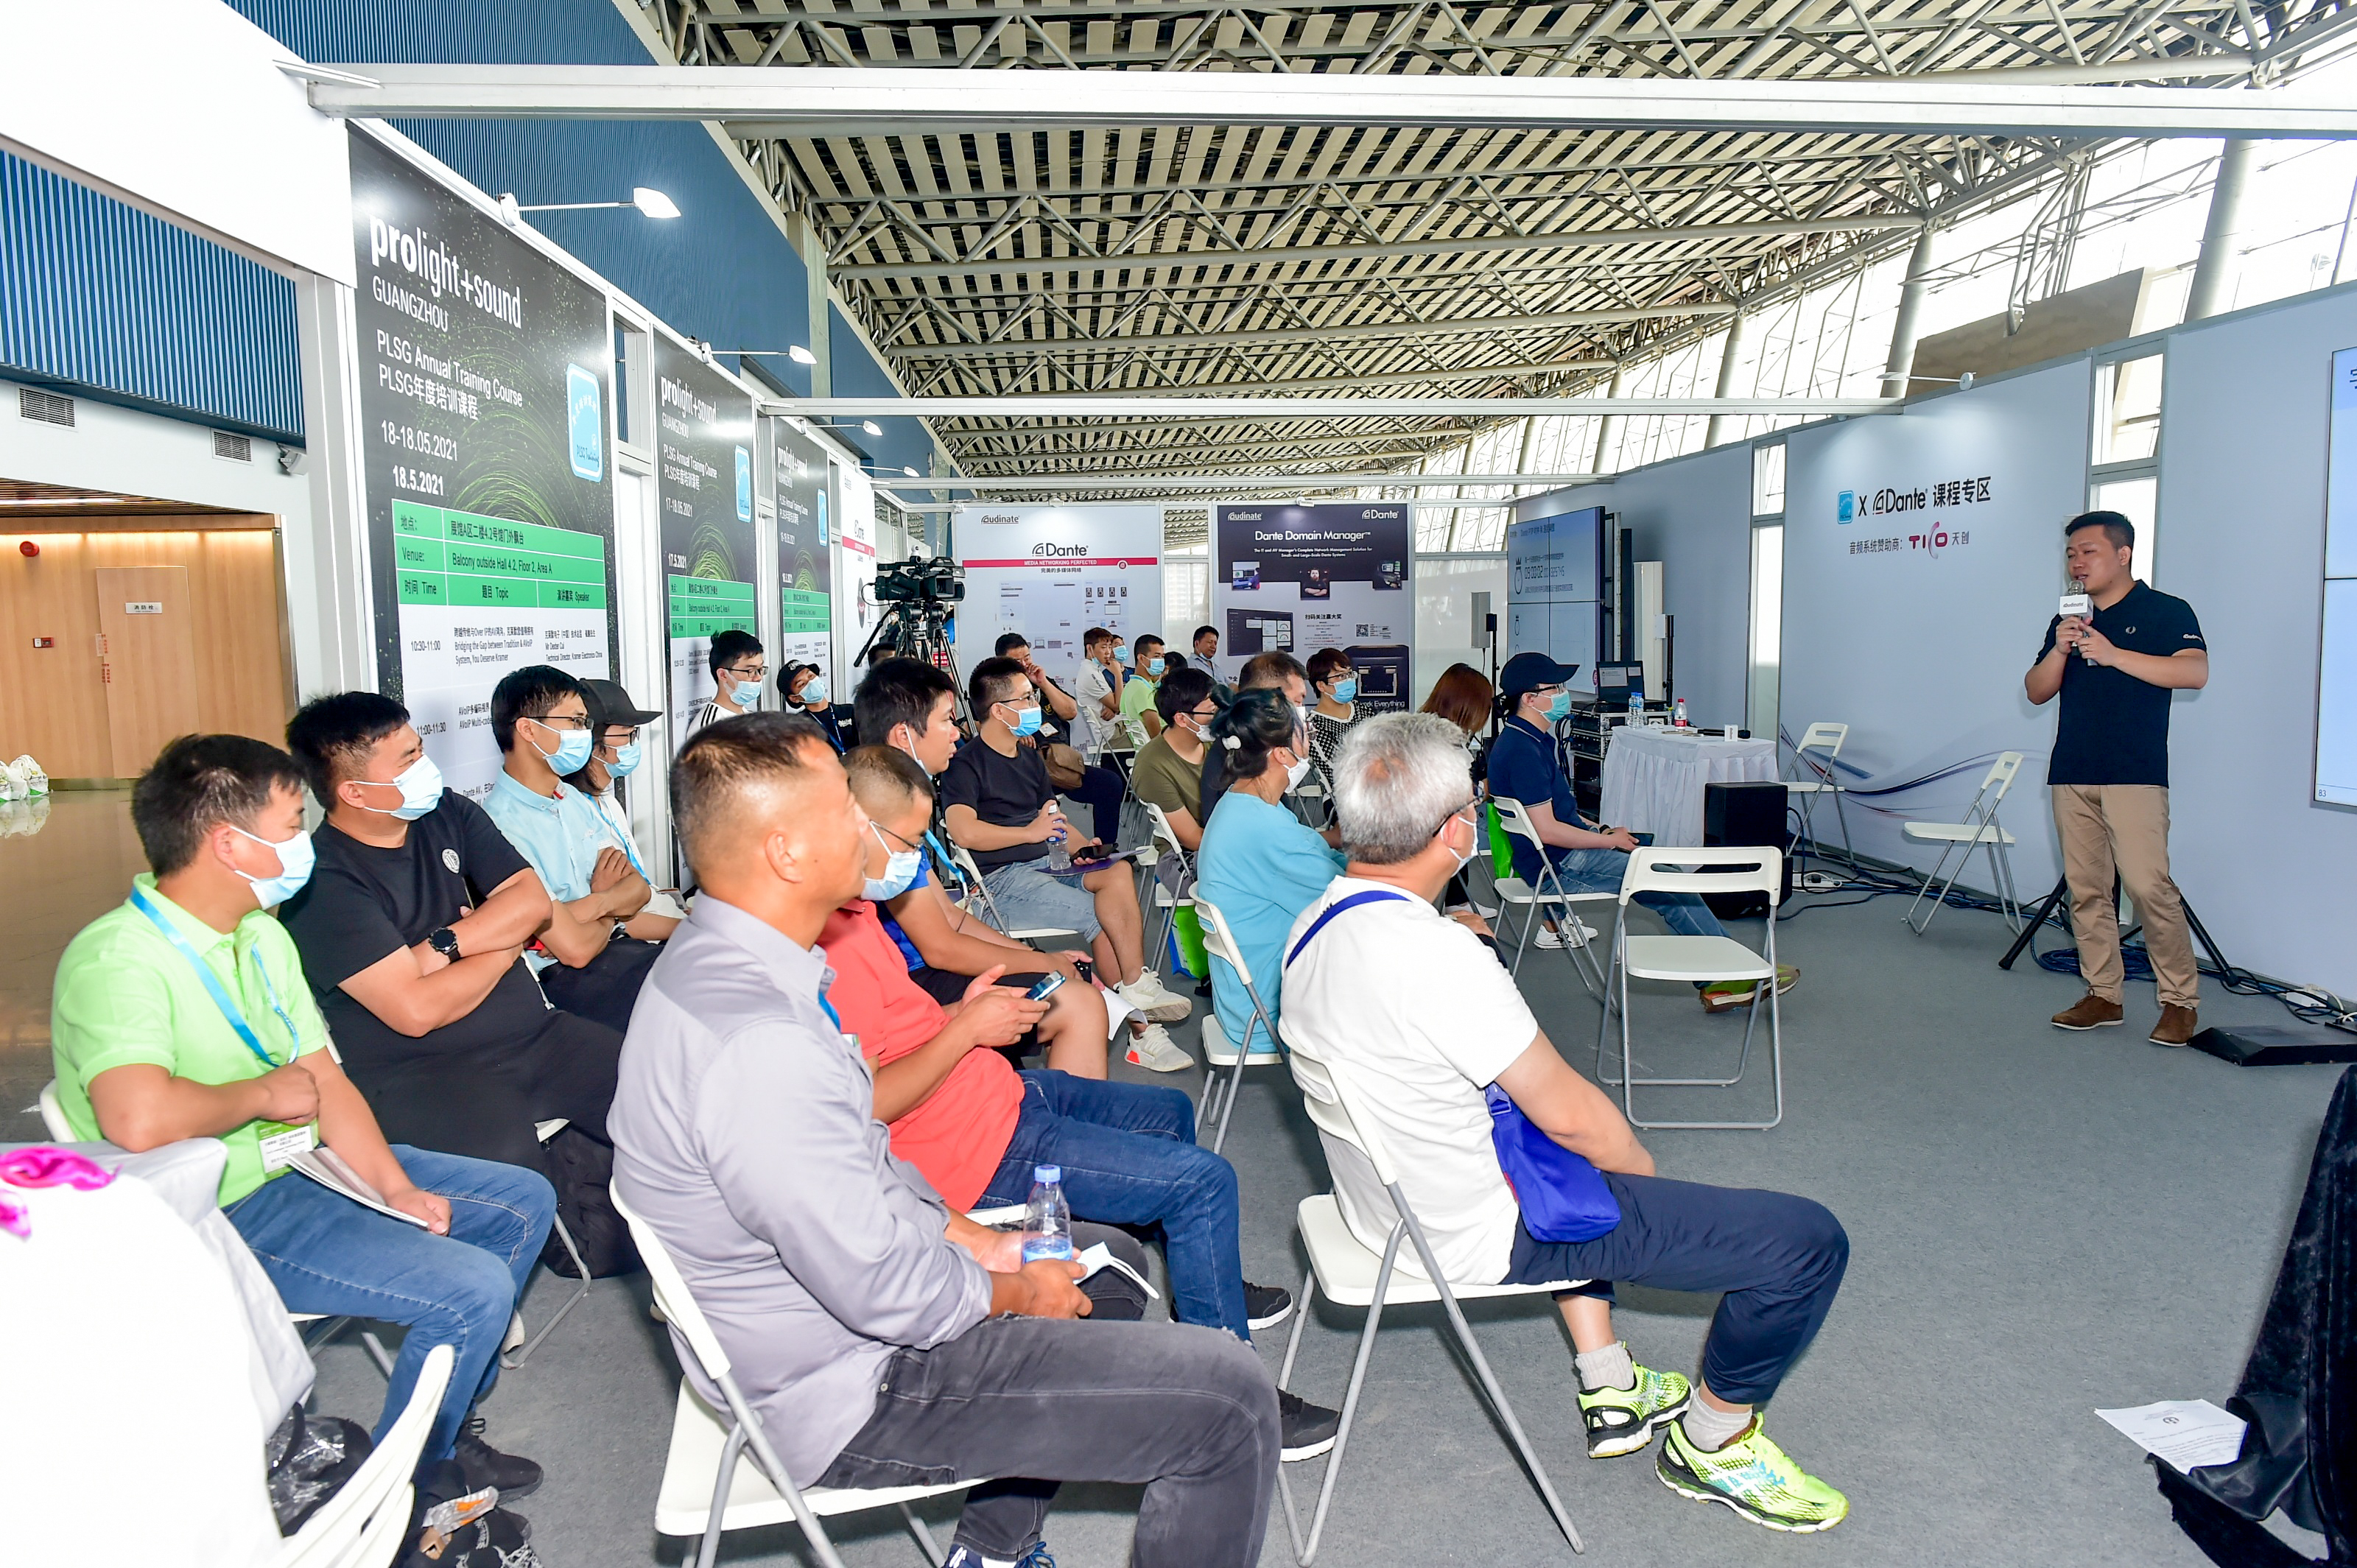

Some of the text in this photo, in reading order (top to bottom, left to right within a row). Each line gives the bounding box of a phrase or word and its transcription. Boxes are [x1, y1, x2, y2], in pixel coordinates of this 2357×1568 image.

[370, 215, 522, 329] prolight+sound
[372, 274, 449, 332] GUANGZHOU
[376, 328, 523, 408] PLSG Annual Training Course
[379, 363, 480, 421] PLSG年度培训课程
[661, 376, 717, 425] prolight+sound
[662, 411, 689, 439] GUANGZHOU
[381, 420, 458, 462] 18-18.05.2021
[663, 443, 717, 479] PLSG Annual Training Course
[393, 465, 444, 496] 18.5.2021
[1886, 488, 1926, 513] Dante
[1933, 476, 1992, 508] 课程专区
[1254, 530, 1284, 541] Dante
[1285, 530, 1322, 541] Domain
[1952, 530, 1970, 546] 天创
[401, 546, 425, 563] Venue:
[1046, 543, 1087, 557] Dante
[452, 552, 475, 571] Balcony
[477, 556, 496, 570] outside
[496, 558, 507, 570] Hall
[519, 560, 531, 572] Floor
[538, 562, 548, 573] Area
[404, 579, 437, 595] 时间 Time
[496, 586, 509, 600] Topic
[575, 591, 590, 603] Speaker
[1374, 700, 1405, 709] Everything
[2318, 789, 2327, 798] 83
